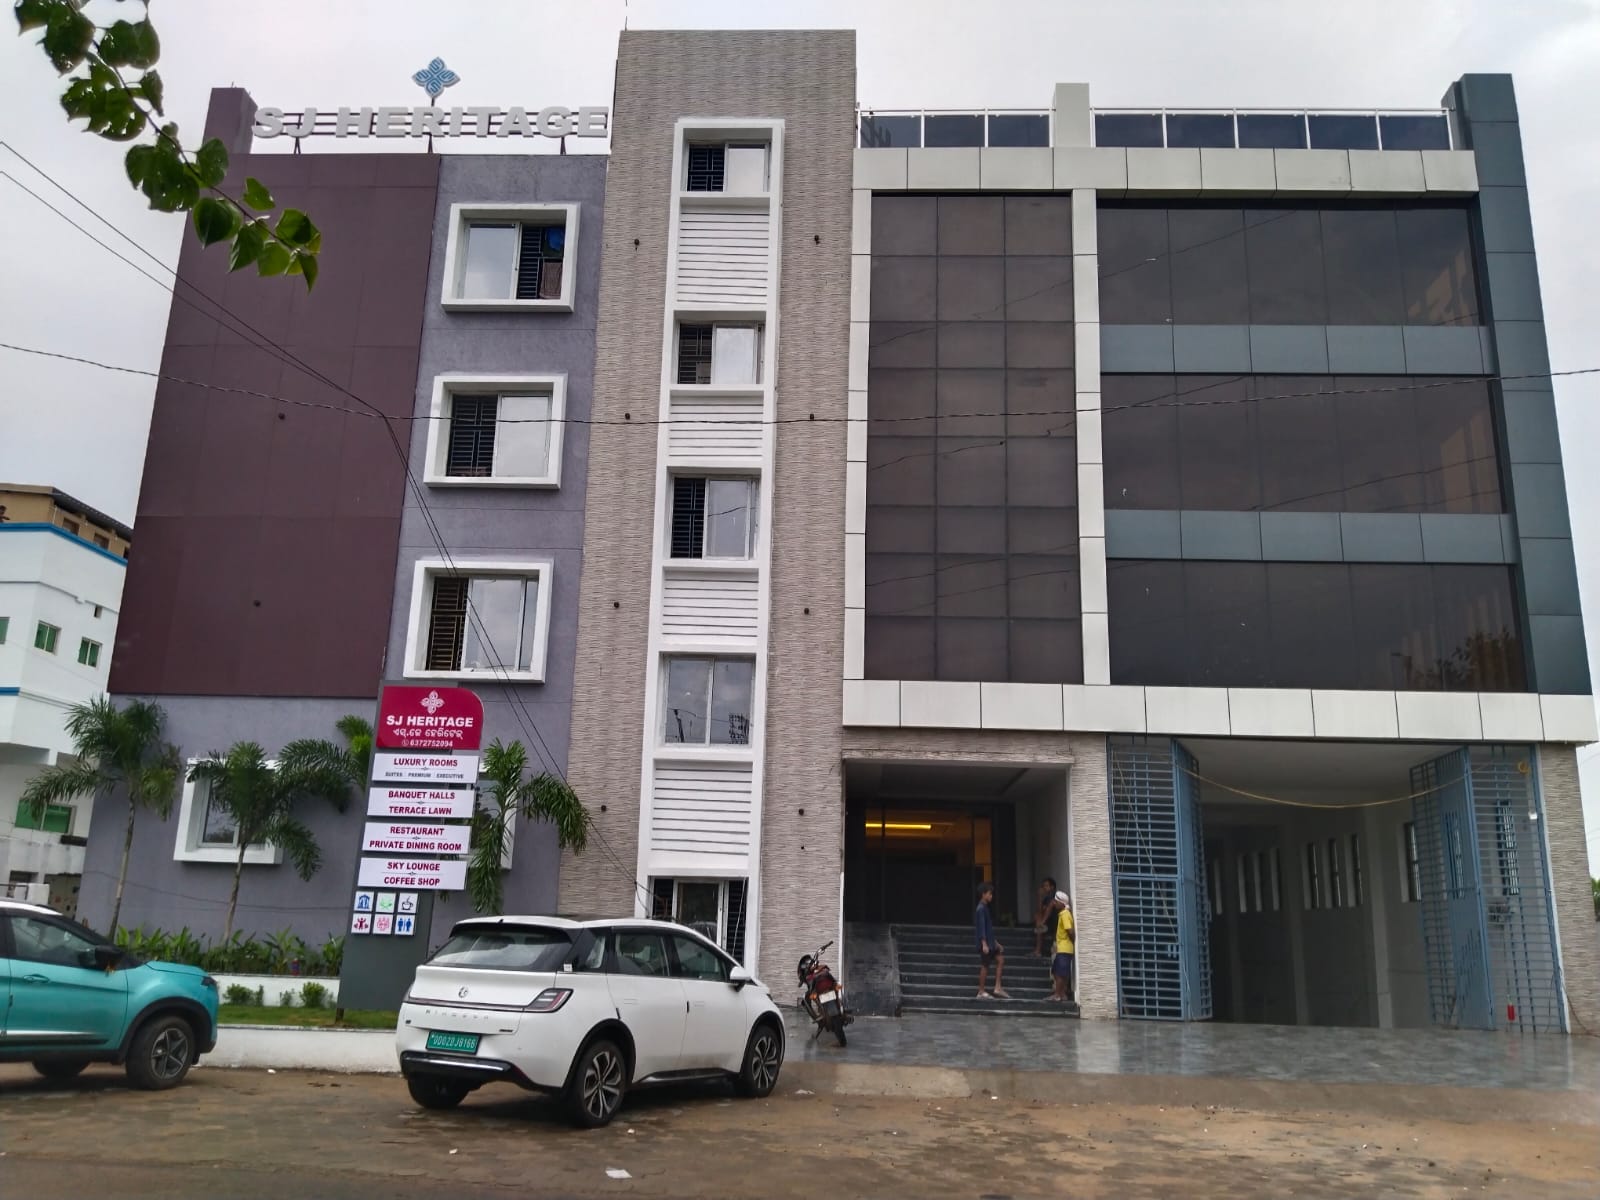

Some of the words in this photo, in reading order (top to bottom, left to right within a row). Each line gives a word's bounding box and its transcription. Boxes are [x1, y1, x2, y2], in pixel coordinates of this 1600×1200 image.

[251, 107, 317, 138] SJ
[335, 105, 609, 138] HERITAGE
[386, 715, 403, 726] SJ
[406, 716, 474, 727] HERITAGE
[393, 758, 427, 766] LUXURY
[429, 759, 458, 767] ROOMS
[388, 790, 427, 799] BANQUET
[429, 791, 456, 799] HALLS
[389, 806, 427, 815] TERRACE
[429, 807, 452, 815] LAWN
[390, 826, 445, 835] RESTAURANT
[369, 840, 404, 849] PRIVATE
[406, 841, 435, 850] DINING
[437, 842, 462, 850] ROOM
[387, 862, 405, 870] SKY
[406, 862, 441, 871] LOUNGE
[384, 876, 416, 885] COFFEE
[417, 877, 441, 886] SHOP
